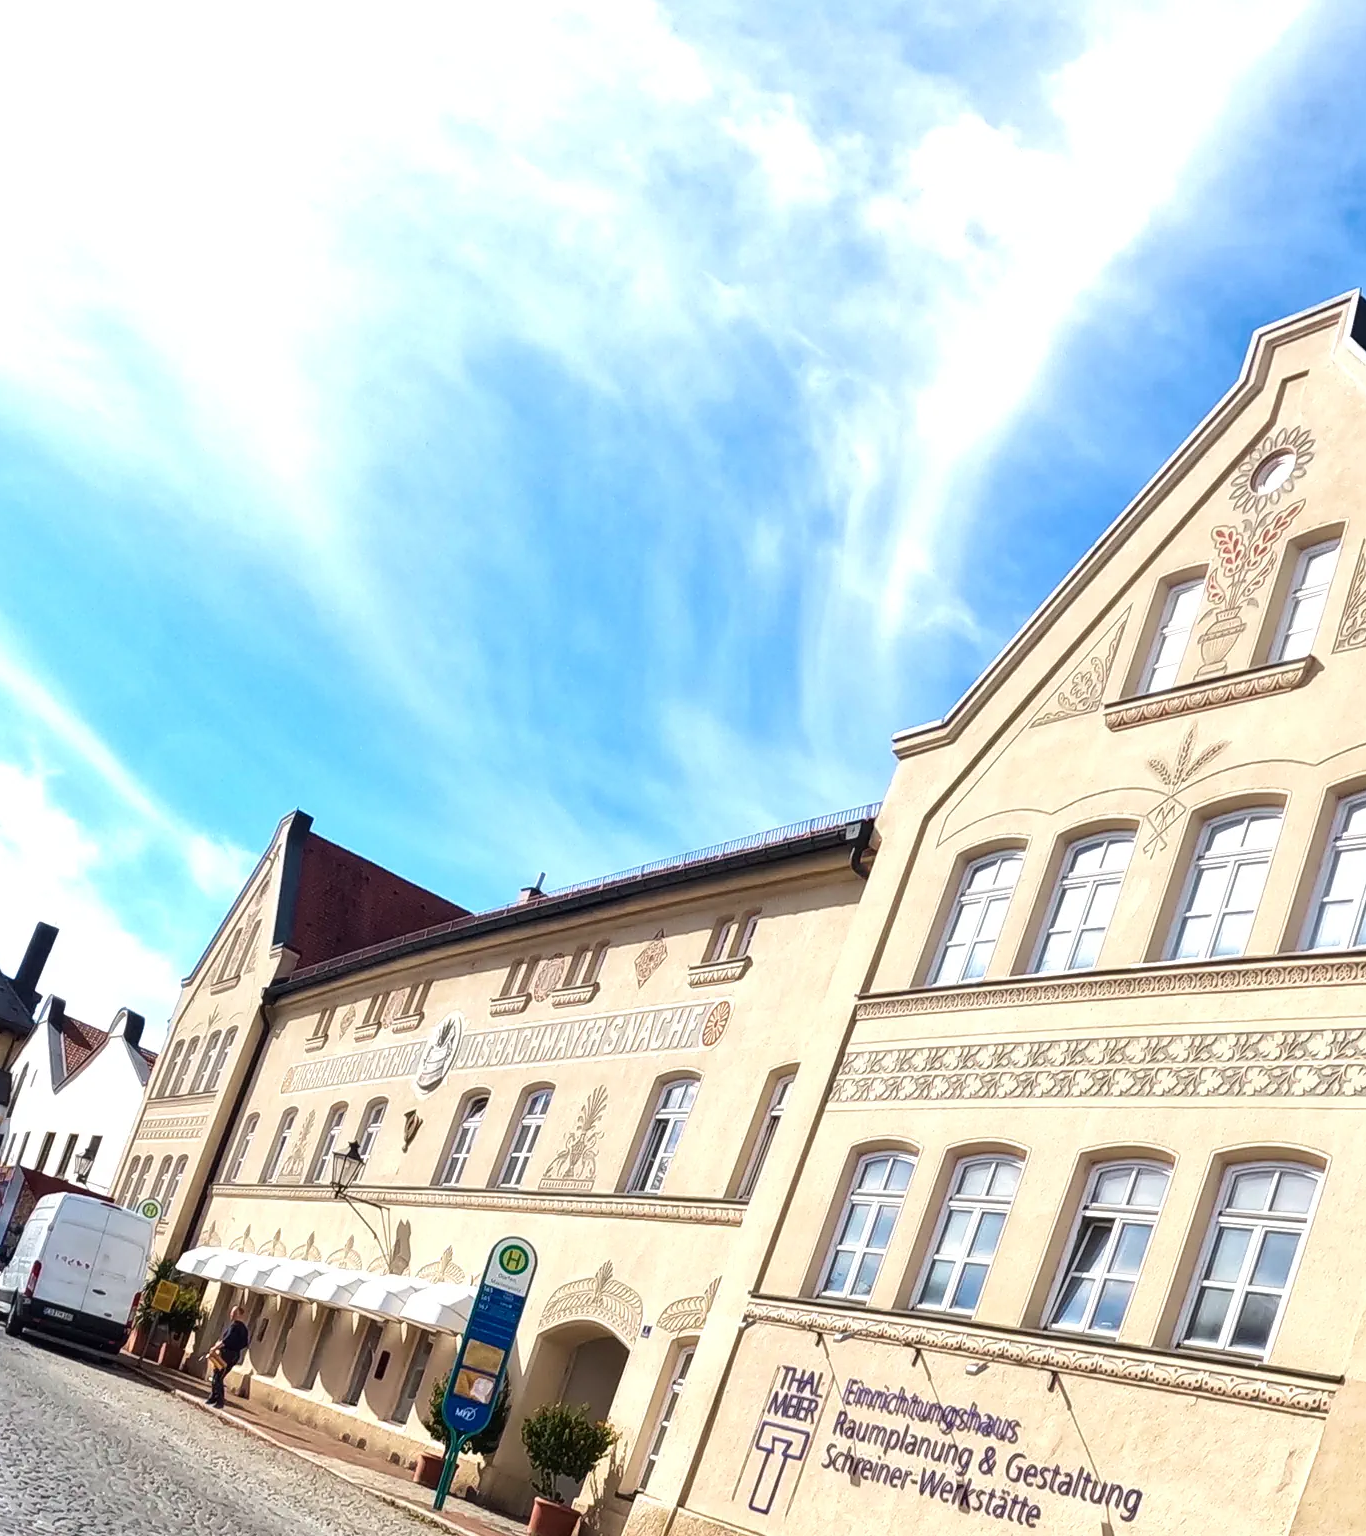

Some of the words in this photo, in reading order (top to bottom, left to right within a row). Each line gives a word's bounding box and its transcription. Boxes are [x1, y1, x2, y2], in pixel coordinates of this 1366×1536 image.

[360, 1042, 423, 1081] GASTHOF
[506, 1250, 522, 1269] H
[780, 1365, 824, 1398] THAL
[843, 1378, 1021, 1444] Einrichtungshaus
[821, 1443, 1041, 1528] Schreiner-Werkstätte
[833, 1410, 974, 1477] Raumplanung
[978, 1446, 997, 1477] &
[1006, 1453, 1143, 1522] Gestaltung
